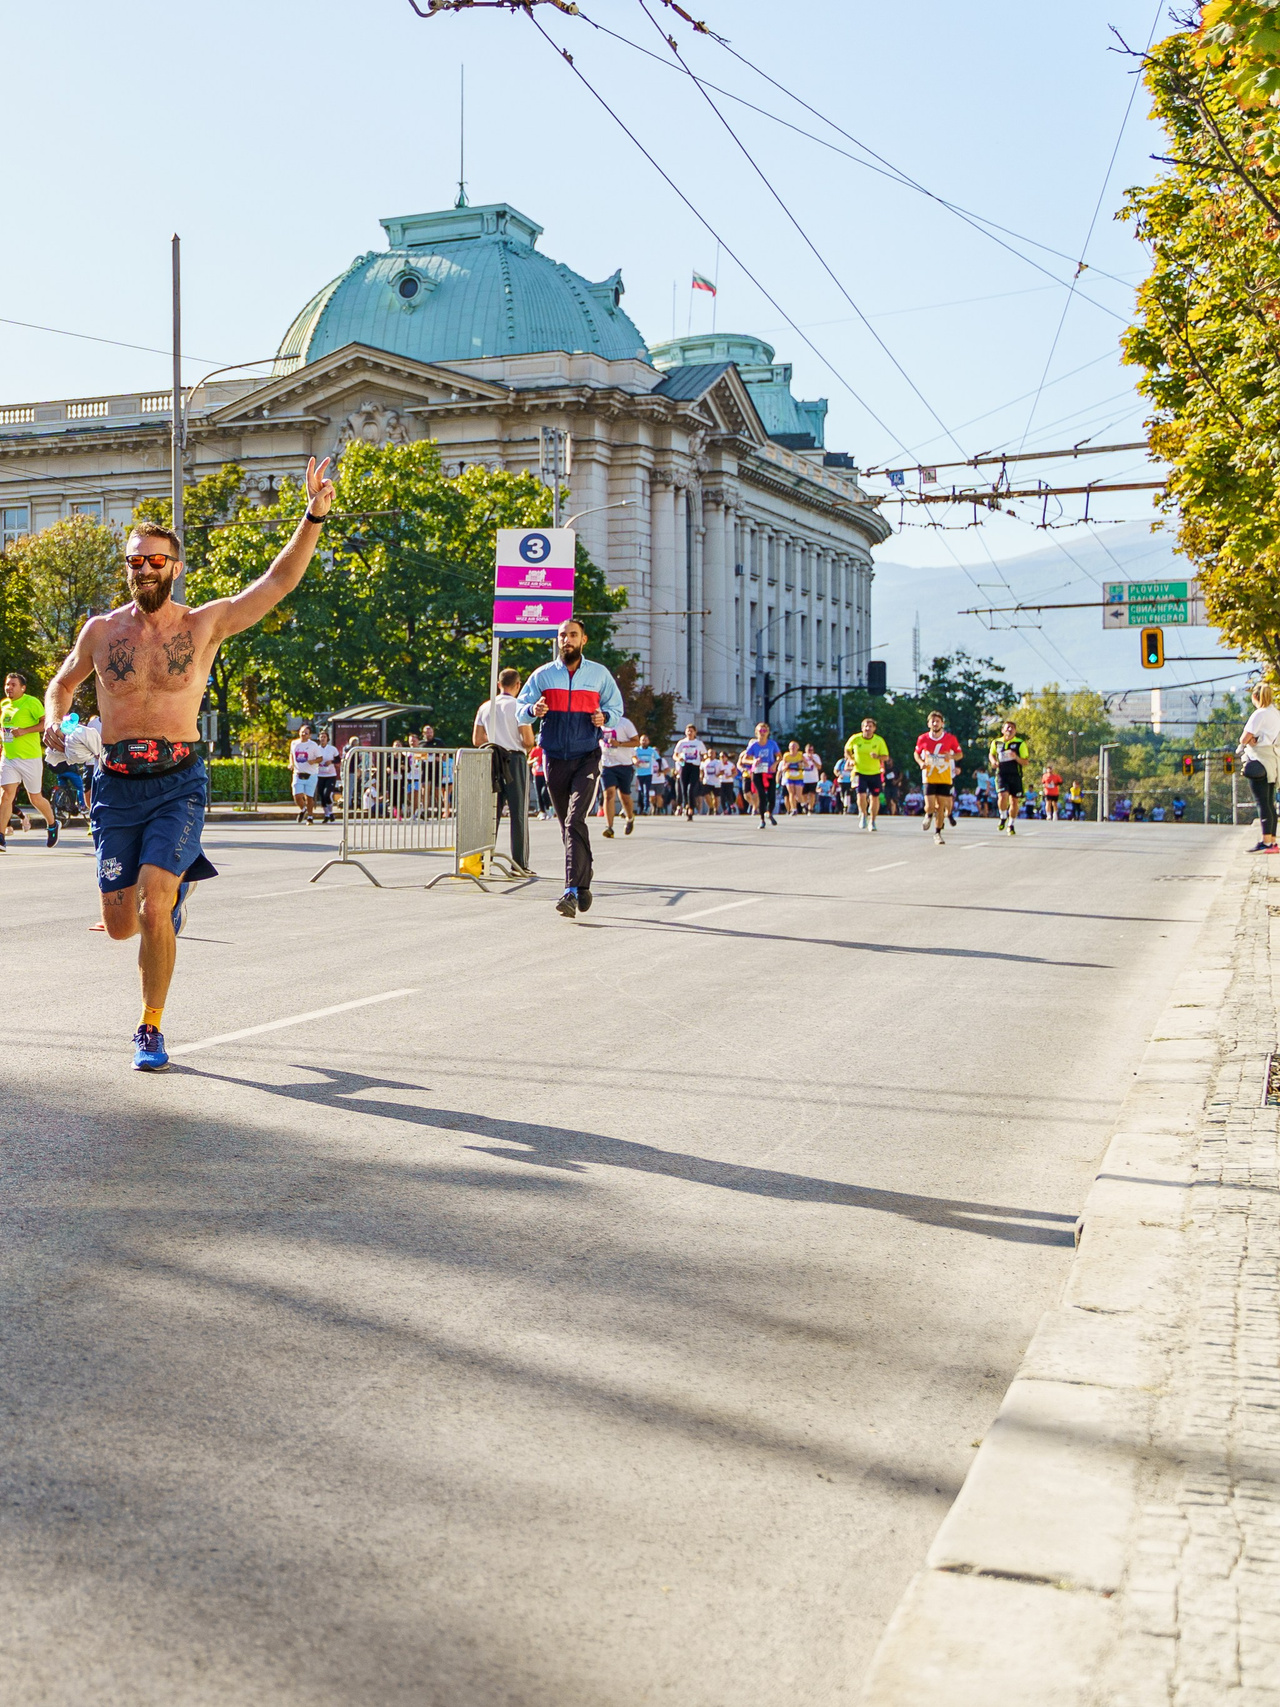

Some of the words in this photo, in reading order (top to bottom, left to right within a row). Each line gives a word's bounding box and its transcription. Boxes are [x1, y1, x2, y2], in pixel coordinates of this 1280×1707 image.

[526, 539, 544, 558] 3
[1130, 584, 1169, 594] PLOVDIV
[1130, 614, 1185, 625] SVILENGRAD
